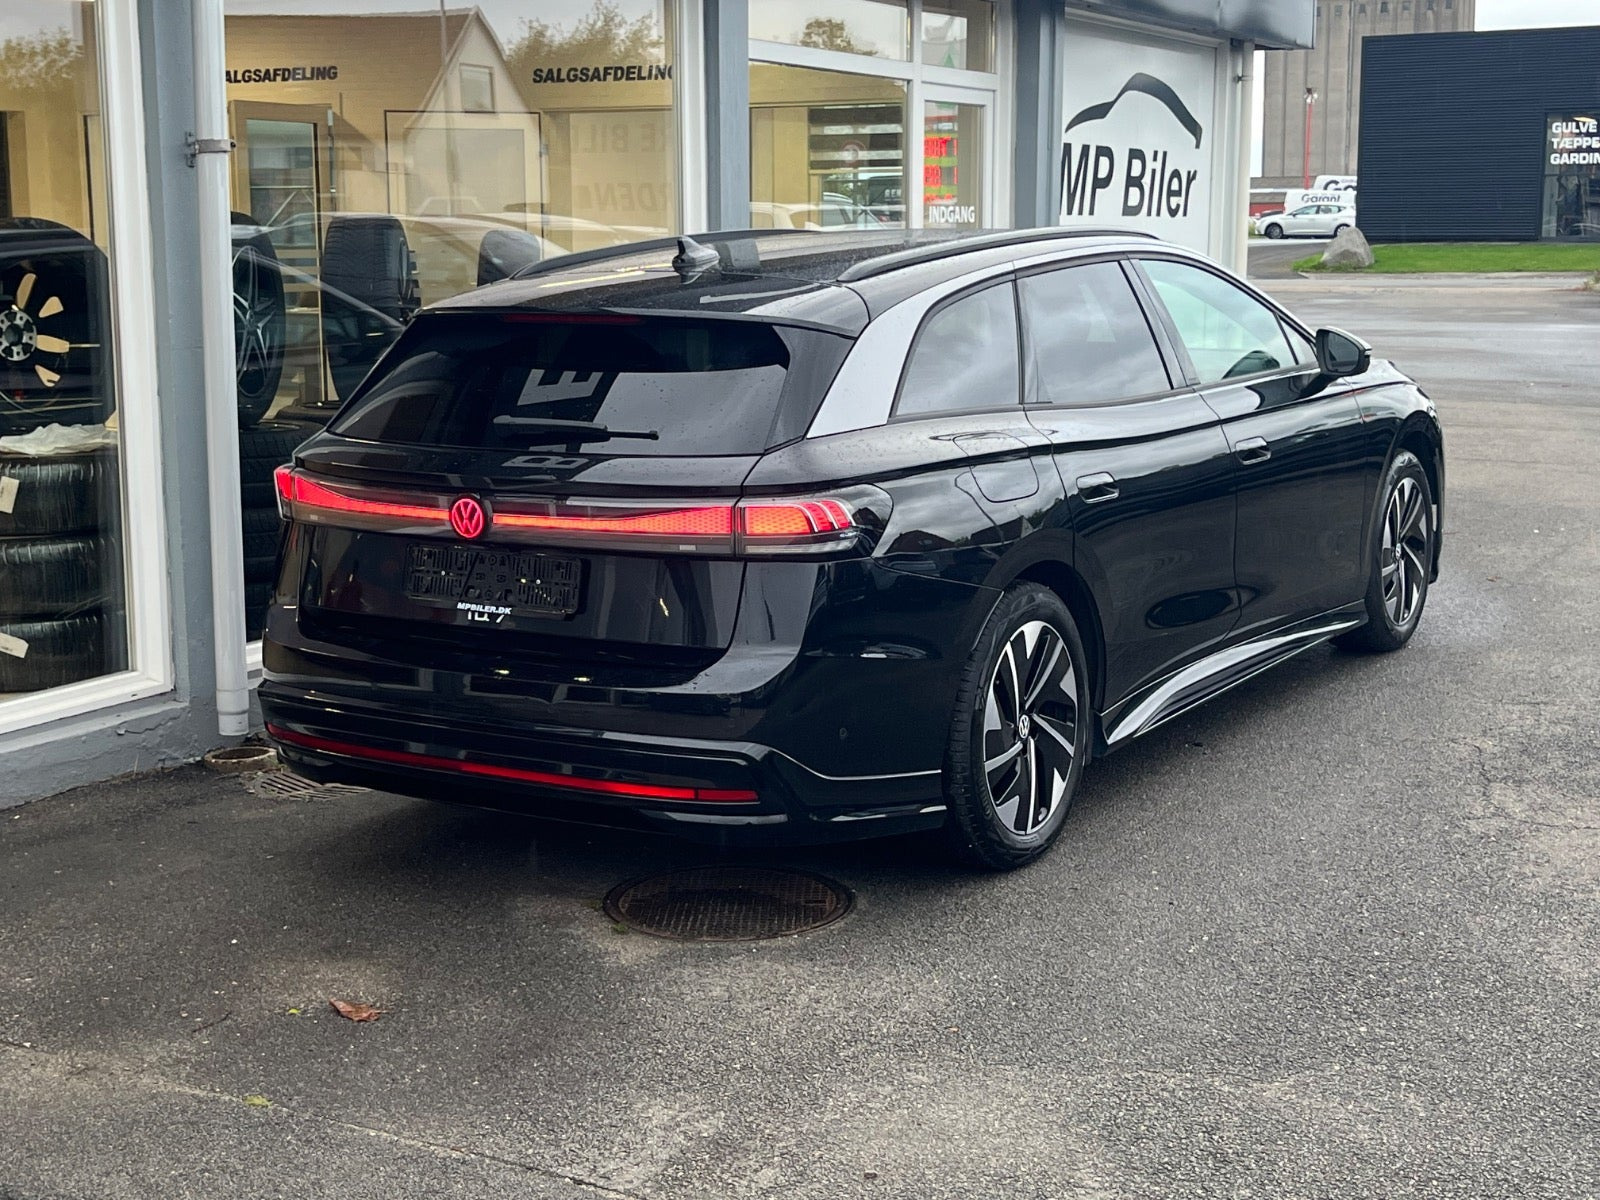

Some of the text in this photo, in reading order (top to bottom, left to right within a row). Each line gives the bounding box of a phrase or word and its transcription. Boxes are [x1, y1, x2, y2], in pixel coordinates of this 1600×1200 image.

[1551, 121, 1597, 133] GULVE
[1060, 142, 1197, 218] MP Biler
[929, 206, 976, 223] INDGANG
[456, 602, 513, 615] MPBILER.DK
